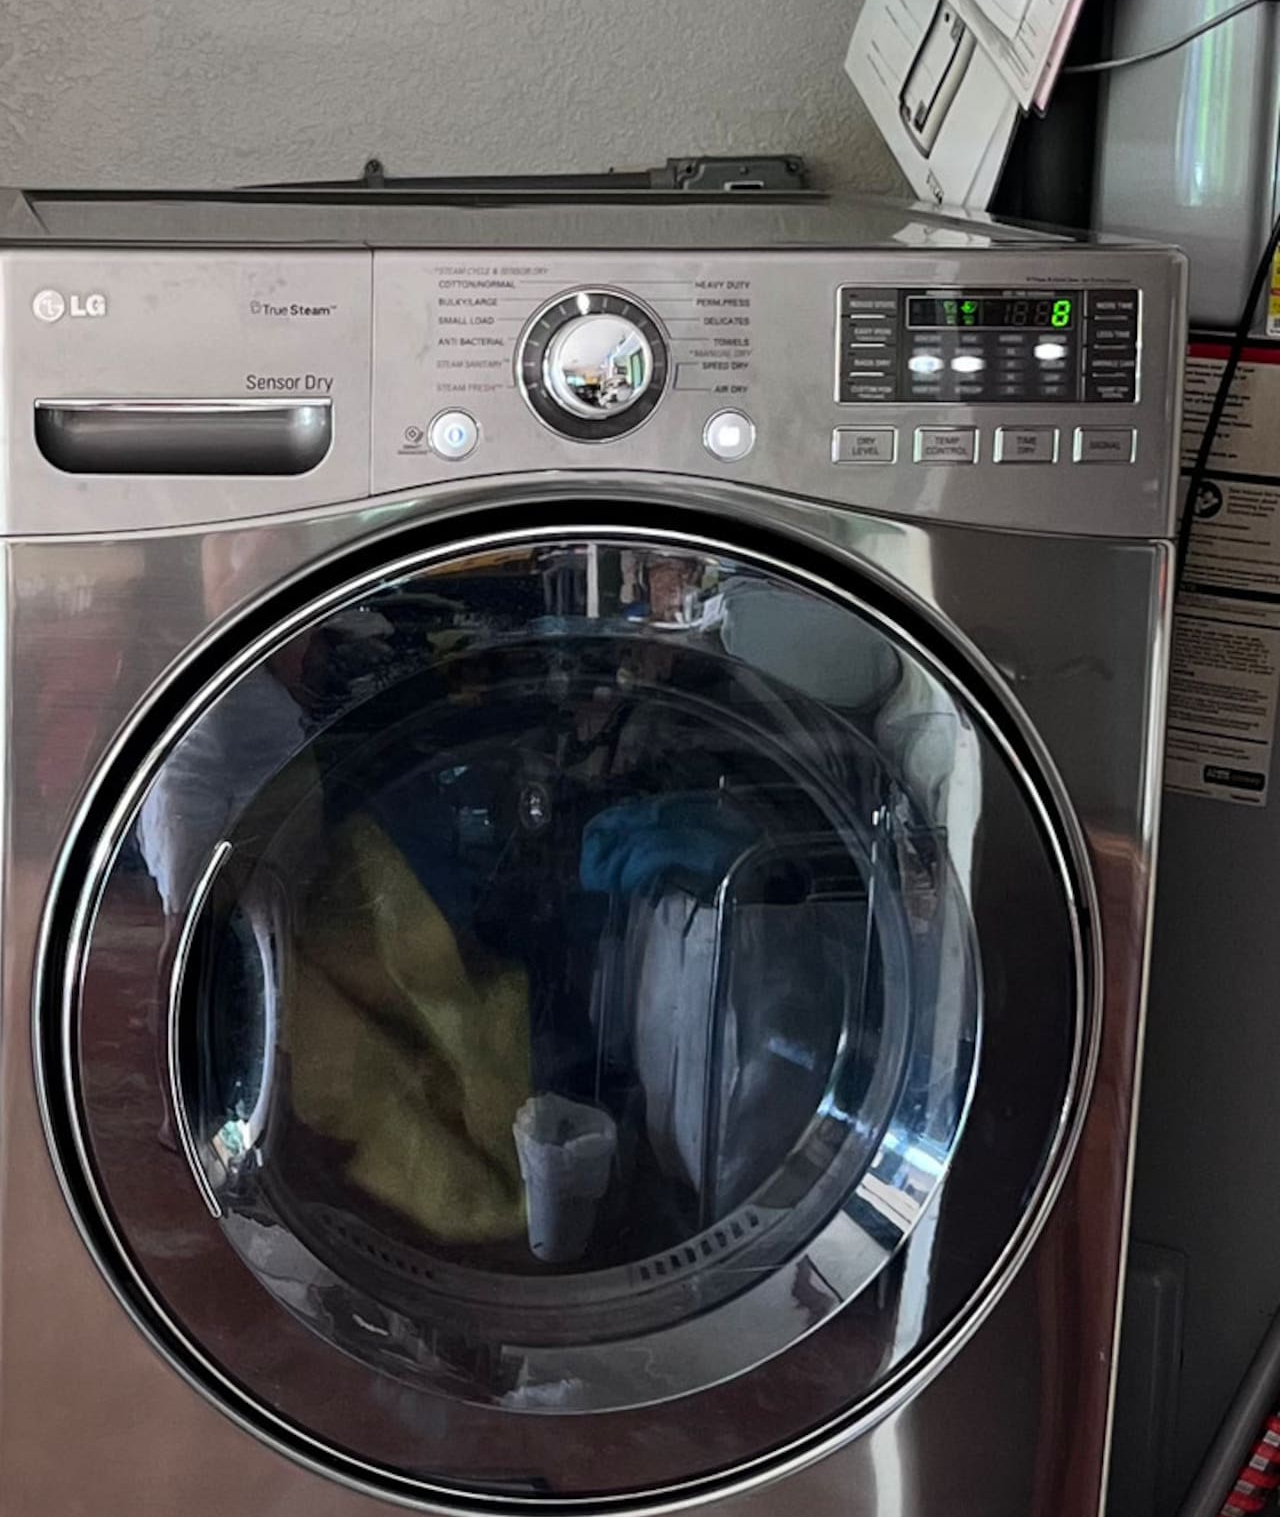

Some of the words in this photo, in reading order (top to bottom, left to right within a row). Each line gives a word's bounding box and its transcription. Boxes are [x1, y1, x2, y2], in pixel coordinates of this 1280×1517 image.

[726, 280, 751, 290] DUTY
[70, 293, 107, 317] LG
[438, 317, 467, 325] SMALL
[470, 317, 495, 325] LOAD
[438, 337, 458, 346] ANTI
[460, 337, 504, 346] BACTERIAL
[245, 374, 301, 391] Sensor
[304, 374, 335, 393] Dry
[856, 437, 875, 445] DRY
[935, 436, 960, 445] TEMP
[851, 448, 880, 457] LEVEL
[925, 447, 969, 456] CONTROL
